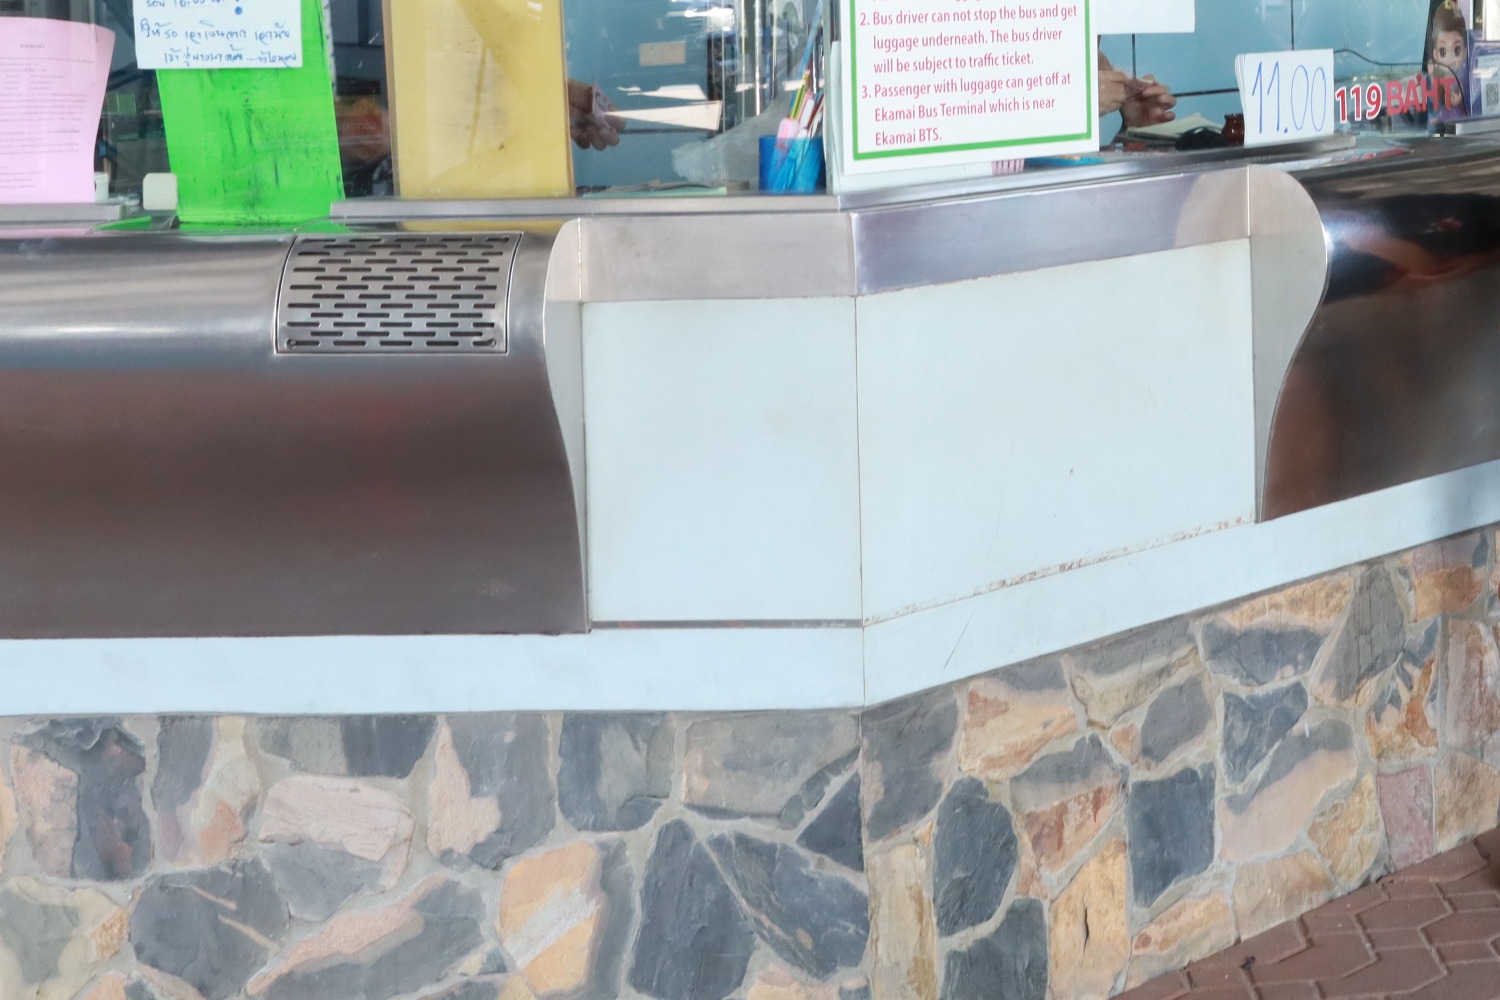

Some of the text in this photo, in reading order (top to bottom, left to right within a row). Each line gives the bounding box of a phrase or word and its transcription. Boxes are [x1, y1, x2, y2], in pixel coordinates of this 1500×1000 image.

[860, 4, 1077, 26] 2. Bus driver can not stop the bus and get
[873, 27, 1062, 53] luggage underneath. The bus driver
[874, 51, 1033, 74] will be subject to traffic ticket.
[862, 71, 1071, 99] 3. Passenger with luggage can get off at
[1252, 60, 1327, 134] 11.00
[875, 97, 1056, 122] Ekamai Bus Terminal which is near
[1334, 76, 1457, 124] 119 BAHT
[875, 127, 942, 146] Ekamai BTS.
